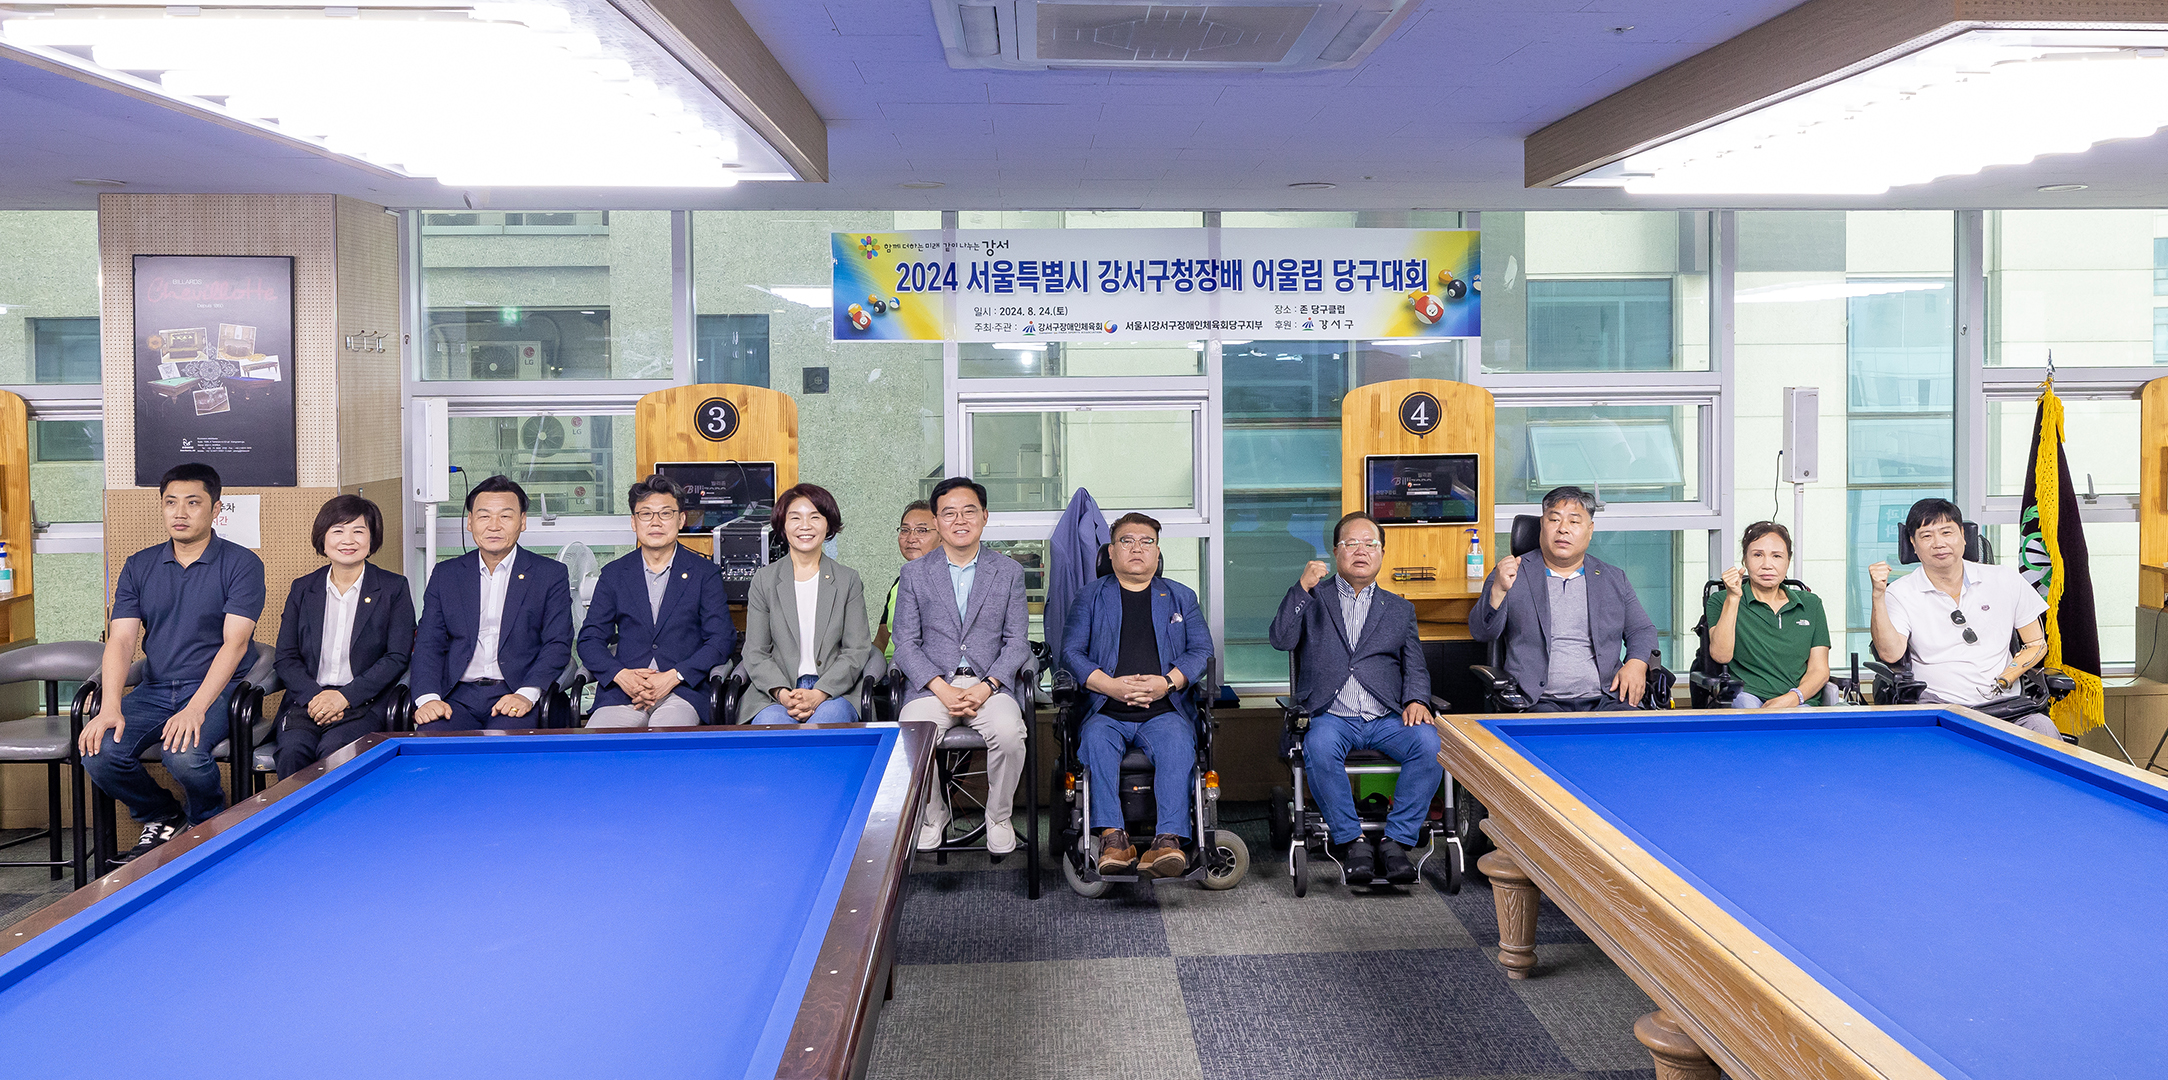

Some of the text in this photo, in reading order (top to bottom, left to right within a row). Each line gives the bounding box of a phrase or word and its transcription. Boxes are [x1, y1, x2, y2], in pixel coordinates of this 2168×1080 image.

[981, 239, 1009, 257] 강서
[896, 258, 1427, 293] 2024 서울특별시 강서구청장배 어울림 당구대회
[973, 306, 991, 317] 일시
[999, 306, 1025, 316] 2024.
[1027, 306, 1036, 316] 8.
[1274, 304, 1292, 315] 장소
[1299, 304, 1309, 315] 존
[1311, 304, 1345, 315] 당구클럽
[1038, 322, 1103, 332] 강서구장애인체육회
[1125, 319, 1263, 331] 서울시강서구장애인체육회당구지부
[1274, 320, 1292, 330] 후원
[707, 406, 727, 433] 3
[1410, 401, 1429, 426] 4
